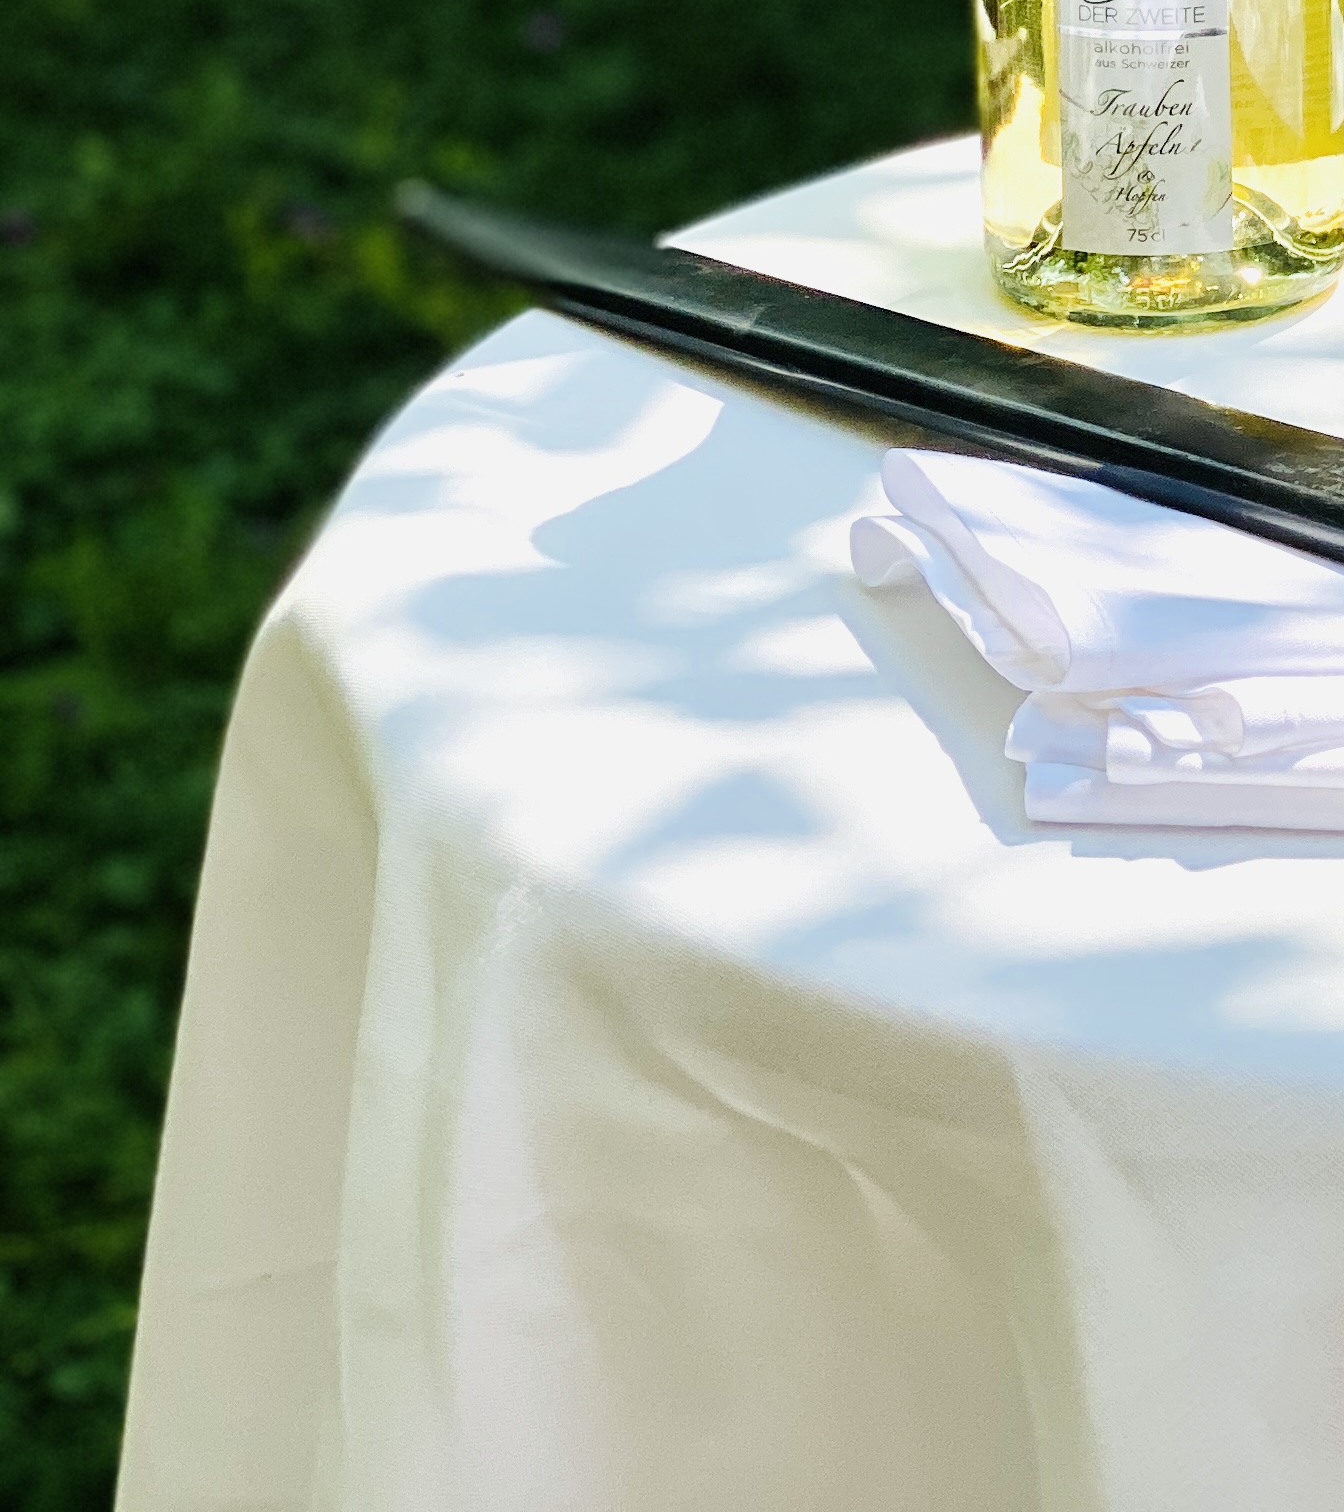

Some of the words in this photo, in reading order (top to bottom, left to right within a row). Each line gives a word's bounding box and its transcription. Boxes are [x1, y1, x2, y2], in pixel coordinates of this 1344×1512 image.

[1078, 4, 1118, 24] DER
[1125, 5, 1206, 25] ZWEITE
[1094, 40, 1190, 55] alkoholfrei
[1095, 59, 1116, 68] aus
[1121, 58, 1191, 69] Schweizer
[1089, 79, 1193, 118] Trauben
[1095, 121, 1184, 181] Äpfeln
[1115, 178, 1166, 219] Hopfen
